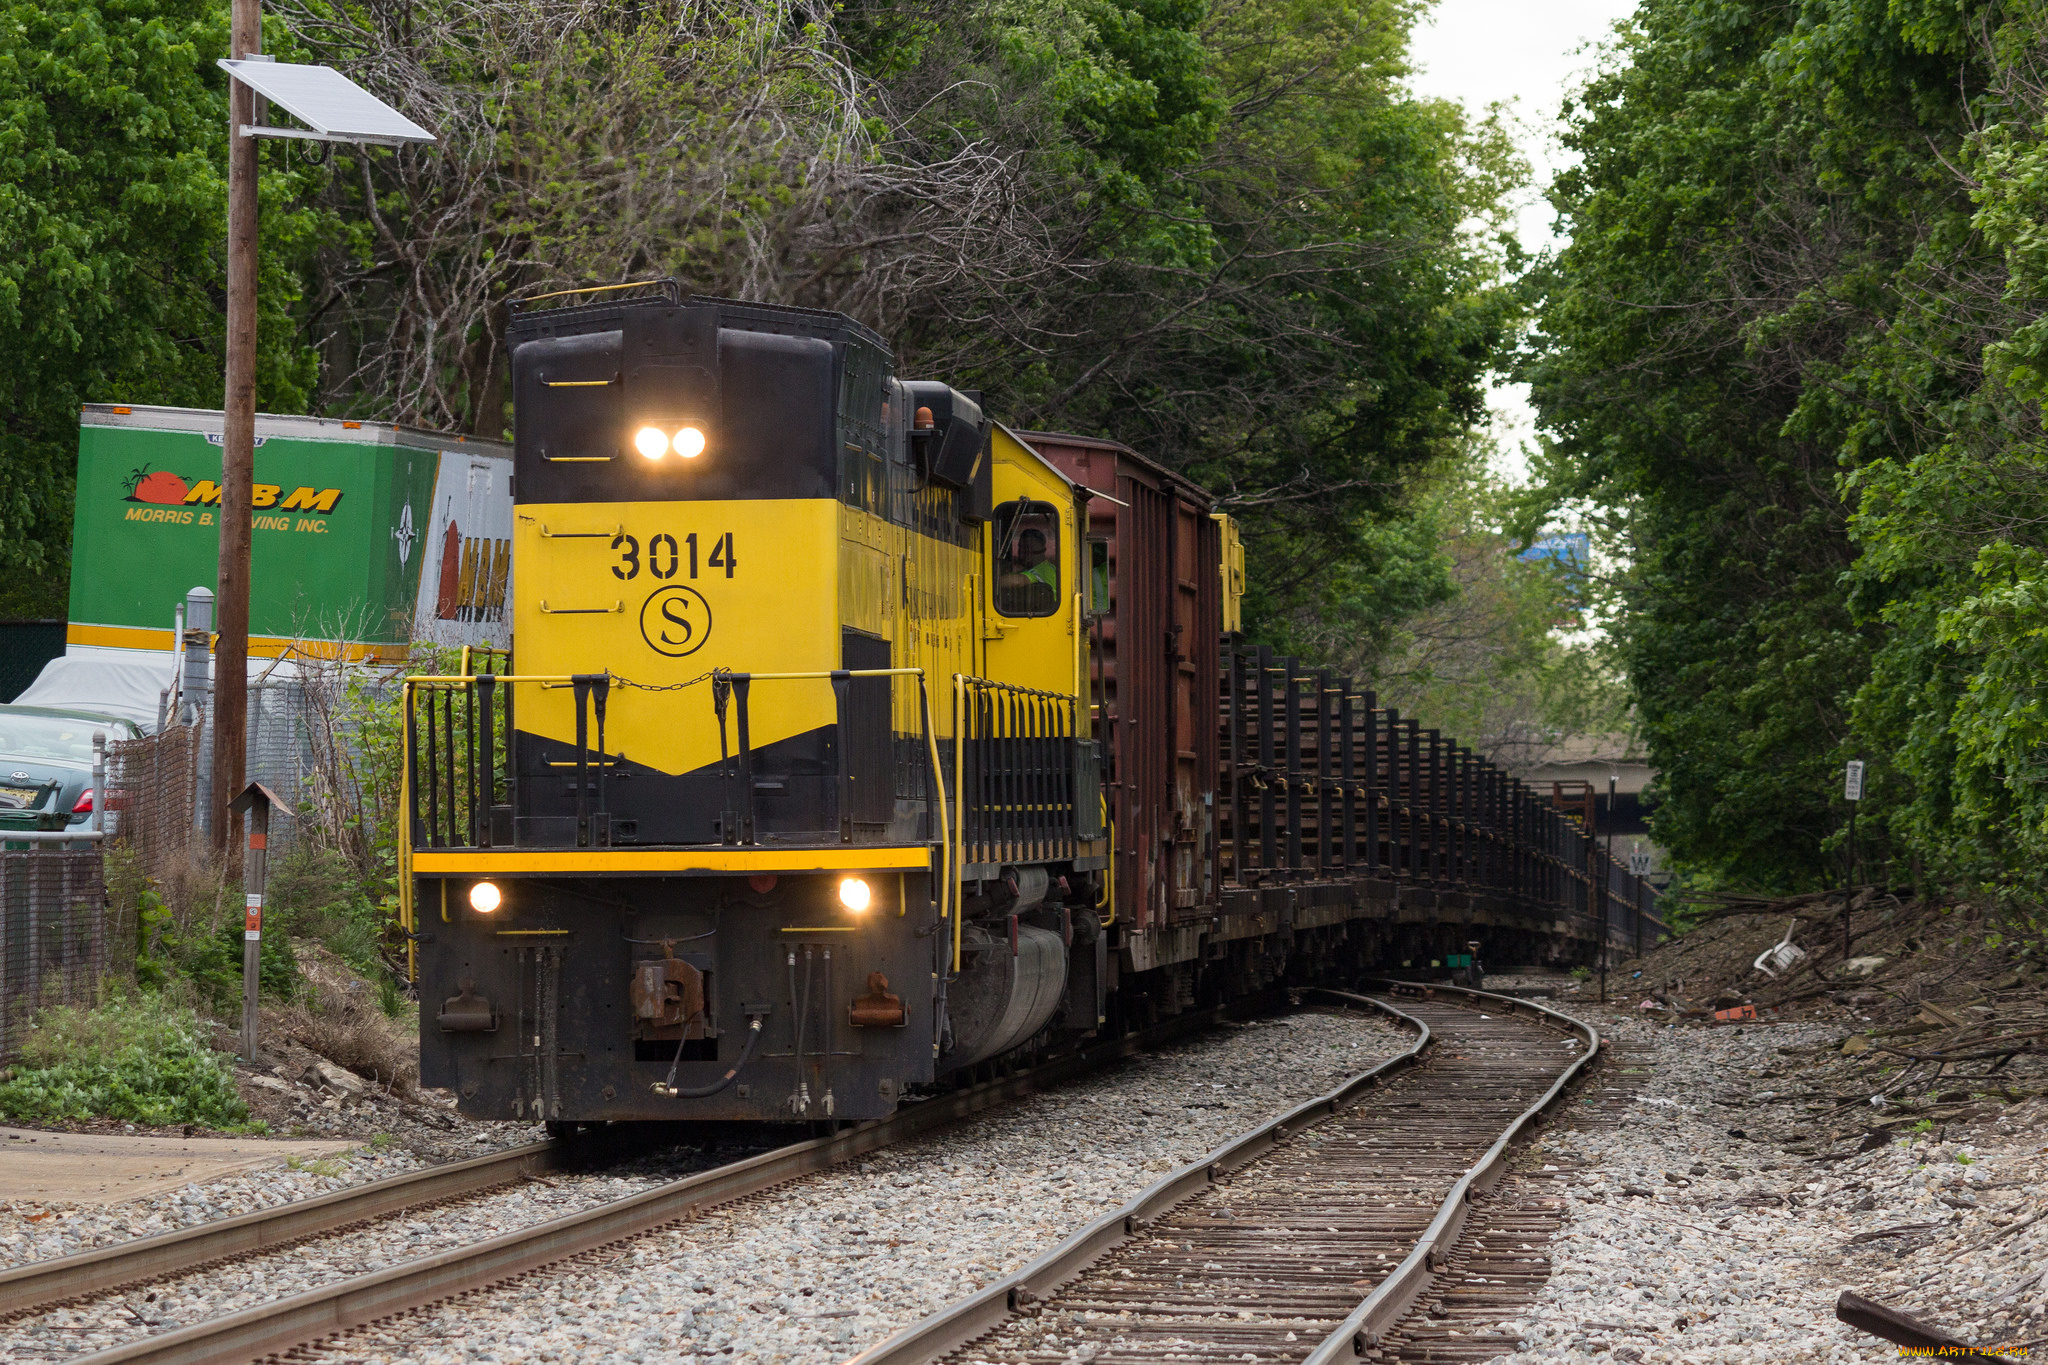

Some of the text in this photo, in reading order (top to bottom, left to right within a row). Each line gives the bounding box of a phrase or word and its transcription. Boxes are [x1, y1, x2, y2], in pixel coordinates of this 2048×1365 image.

[125, 508, 329, 534] MORRIS B. VING INC.
[611, 532, 737, 580] 3014
[661, 597, 692, 645] S
[1631, 855, 1650, 872] W
